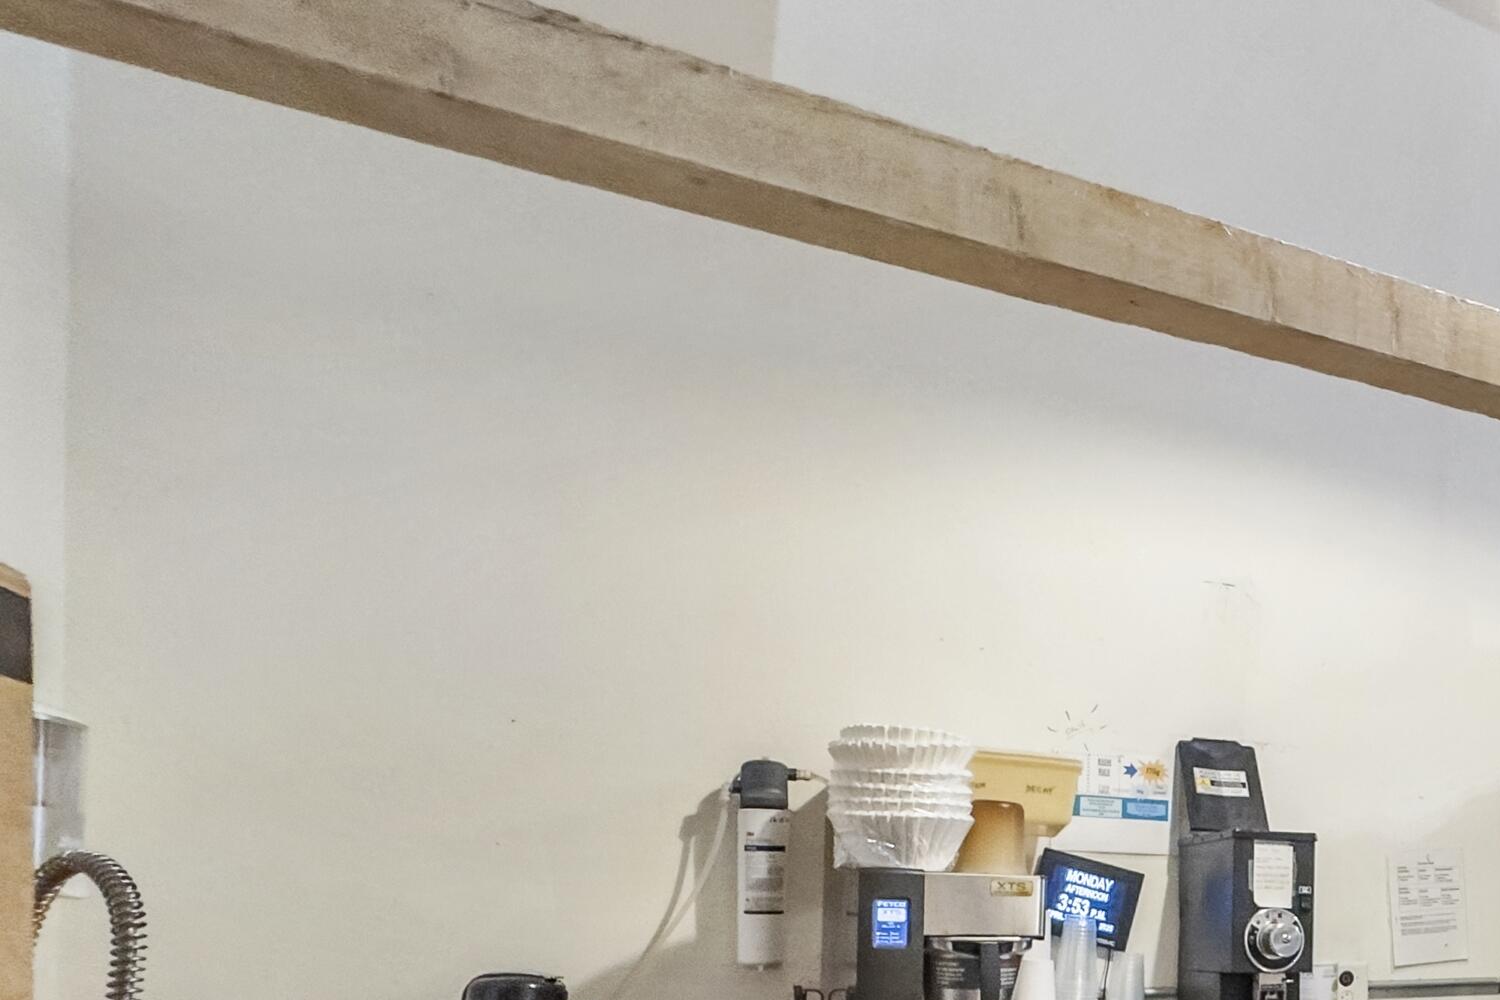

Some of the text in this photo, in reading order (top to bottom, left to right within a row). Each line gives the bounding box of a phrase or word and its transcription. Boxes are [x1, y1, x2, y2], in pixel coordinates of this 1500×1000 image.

[996, 881, 1027, 891] XTS
[1065, 868, 1114, 892] MONDAY
[1064, 883, 1110, 903] AFTERNOON
[1056, 893, 1090, 917] 3:53
